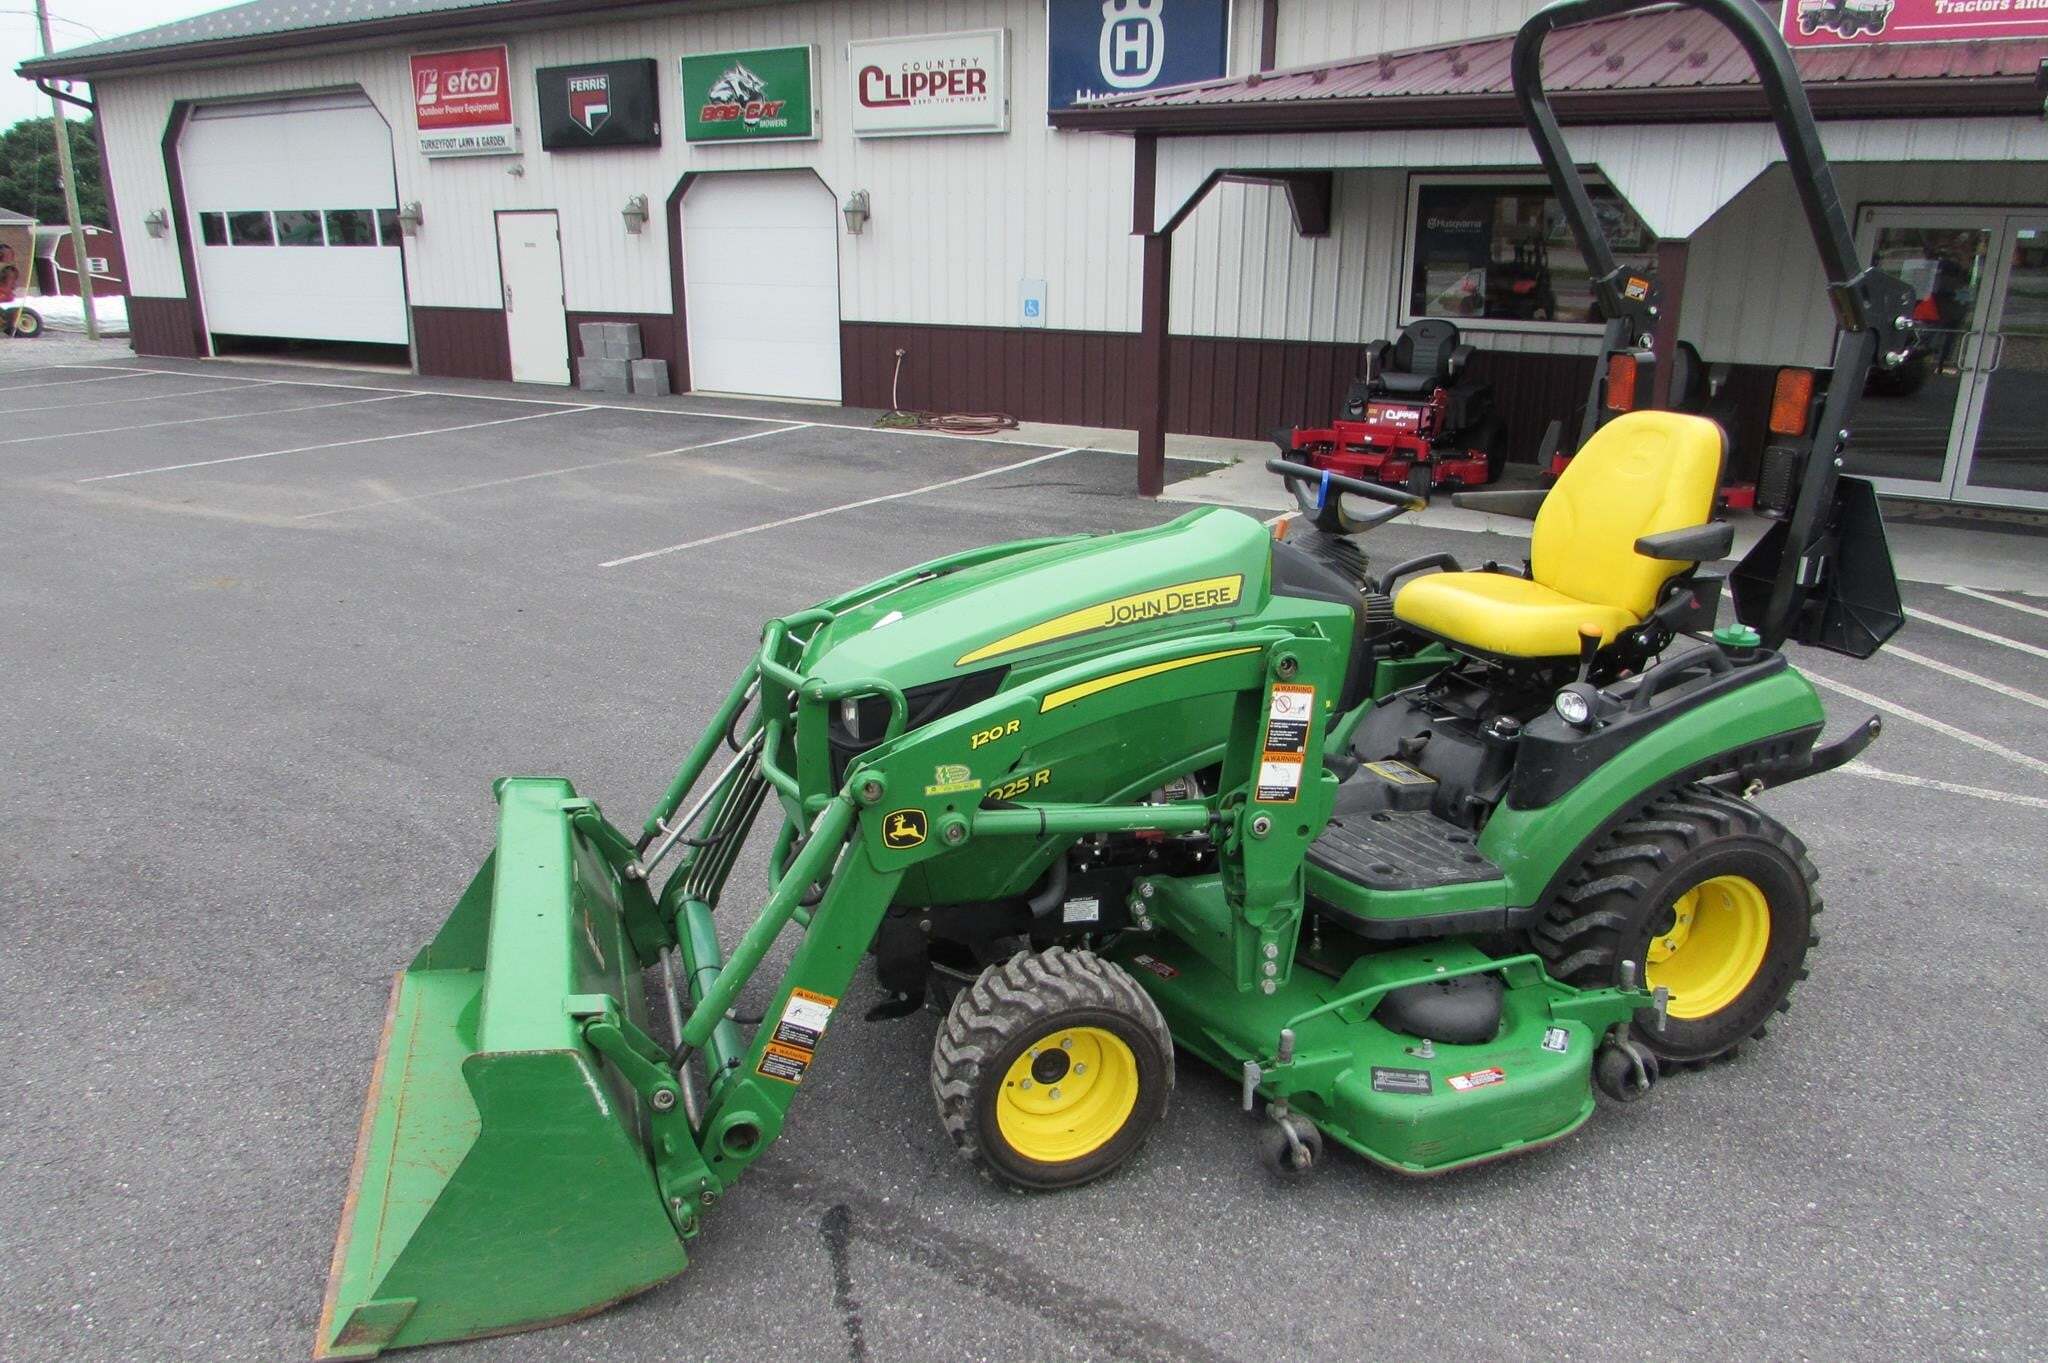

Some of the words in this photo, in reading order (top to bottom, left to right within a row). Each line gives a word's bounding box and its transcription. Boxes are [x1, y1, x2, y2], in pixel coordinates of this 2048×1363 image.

[1935, 0, 2010, 14] Tractors
[1115, 23, 1148, 71] H
[902, 57, 980, 72] COUNTRY
[447, 67, 492, 93] efco
[570, 78, 607, 92] FERRIS
[858, 64, 987, 108] CLIPPER
[418, 104, 445, 116] Outdoor
[445, 103, 465, 114] Power
[465, 102, 500, 114] Equipment
[759, 118, 788, 128] MOWERS
[420, 137, 457, 150] TURKEYFOOT
[458, 137, 475, 148] LAWN
[481, 135, 506, 147] GARDEN
[1104, 599, 1161, 625] JOHN
[1166, 587, 1231, 612] DEERE
[1280, 685, 1312, 694] WARNING
[971, 726, 1004, 750] 120
[1006, 719, 1021, 735] R
[985, 776, 1030, 801] 025
[1034, 768, 1051, 787] R
